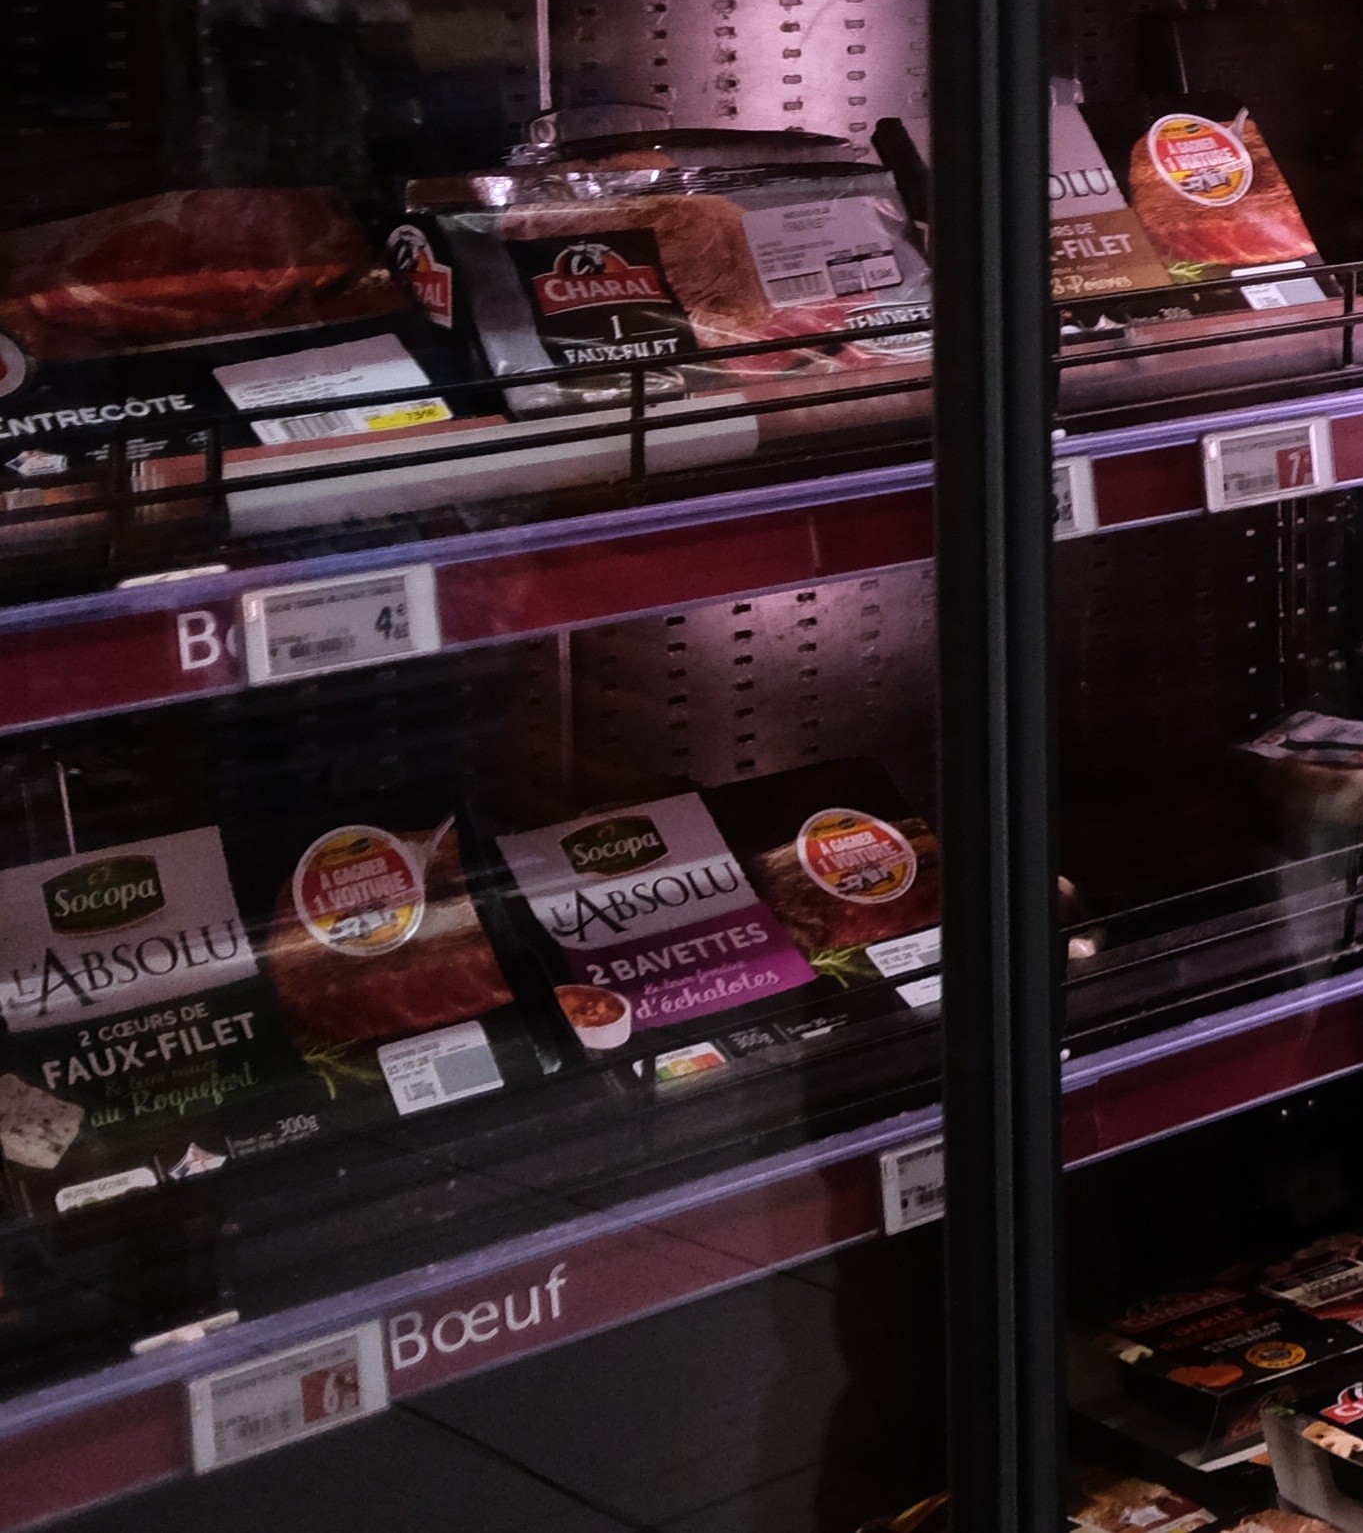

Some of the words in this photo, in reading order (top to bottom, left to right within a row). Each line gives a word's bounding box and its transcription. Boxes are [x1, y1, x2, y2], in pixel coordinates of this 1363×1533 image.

[1050, 233, 1133, 261] -FILET
[544, 273, 662, 304] CHARAL
[609, 314, 625, 339] 1
[562, 337, 680, 366] FAUX-FILET
[373, 605, 393, 642] 4
[571, 830, 660, 868] Socopa
[53, 874, 159, 919] Socopa
[586, 963, 611, 987] 2
[610, 921, 770, 983] BAVETTES
[635, 969, 780, 1020] d'échalotes
[77, 1029, 92, 1049] 2
[97, 1009, 178, 1042] CŒURS
[180, 1002, 209, 1025] DE
[41, 1010, 256, 1090] FAUX-FILET
[90, 1107, 125, 1128] au
[131, 1061, 261, 1117] Roquefort
[276, 1113, 321, 1137] 300g
[388, 1262, 568, 1371] Bœuf
